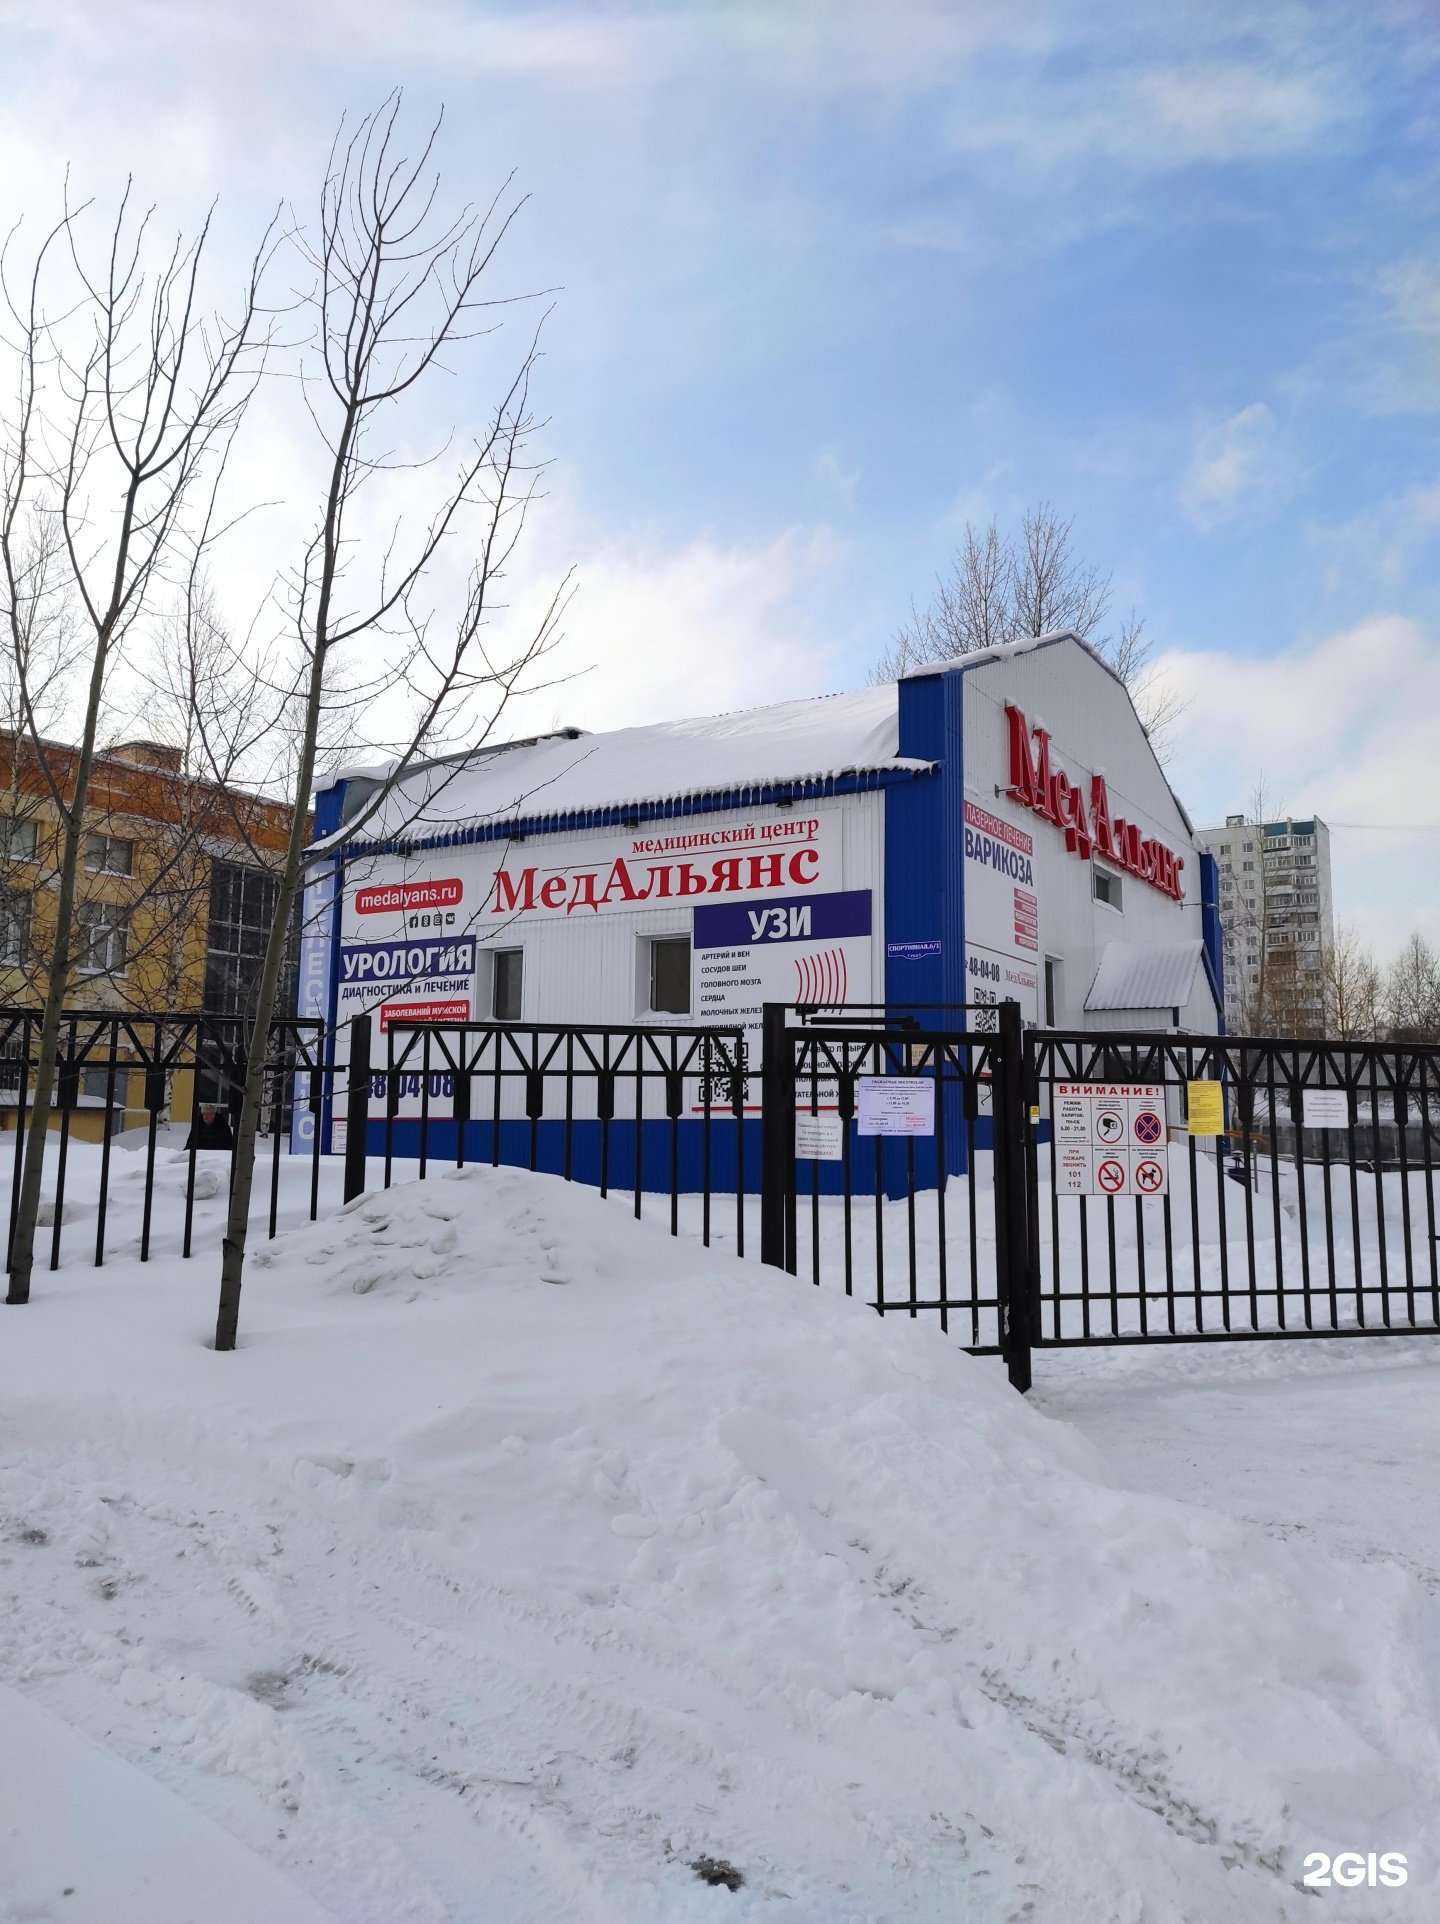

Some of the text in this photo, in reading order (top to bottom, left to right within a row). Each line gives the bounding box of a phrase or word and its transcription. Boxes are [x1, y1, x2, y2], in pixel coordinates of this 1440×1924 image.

[966, 803, 1003, 837] ЛАЗЕРНОЕ
[632, 818, 819, 854] медицинский центр
[965, 828, 1033, 887] ВАРИКОЗА
[491, 848, 820, 915] МедАльянс
[361, 883, 457, 908] medalyans.ru
[748, 905, 812, 941] УЗИ
[343, 943, 472, 979] УРОЛОГИЯ
[701, 951, 730, 960] АРТЕРИЙ
[701, 964, 747, 974] СОСУДОВ ШЕИ
[969, 957, 1000, 982] 48-04-08
[342, 982, 412, 1000] ДИАГНОСТИКА
[423, 979, 469, 993] ЛЕЧЕНИЕ
[701, 978, 762, 989] ГОЛОВНОГО МОЗГА
[701, 994, 726, 1002] СЕРДЦА
[384, 1003, 467, 1018] ЗАБОЛЕВАНИЙ МУЖСКОЙ
[701, 1008, 739, 1016] МОЛОЧНЫХ
[1059, 1086, 1159, 1096] ВНИМАНИЕ!
